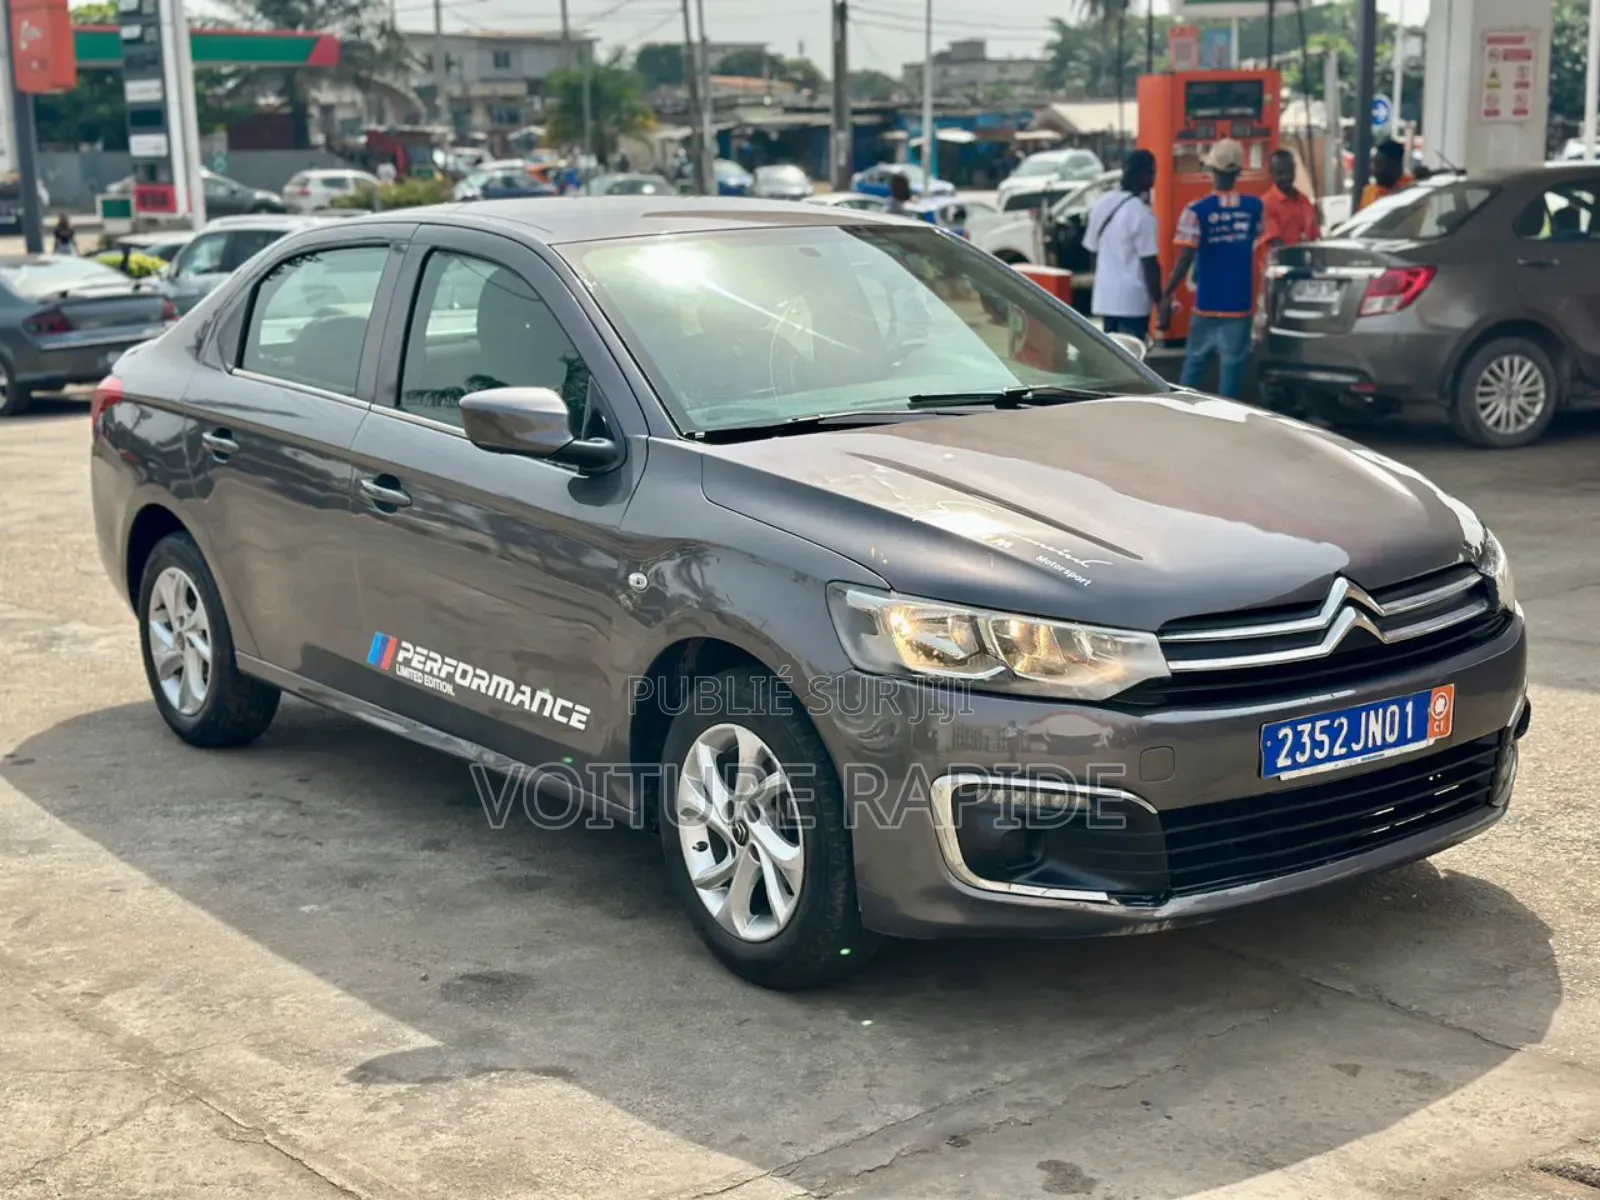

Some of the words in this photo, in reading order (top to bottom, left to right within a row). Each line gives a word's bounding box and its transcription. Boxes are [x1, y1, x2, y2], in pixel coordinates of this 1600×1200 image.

[1035, 555, 1092, 587] Motorsport
[395, 663, 424, 685] LIMITED
[396, 640, 591, 731] PERFORMANCE
